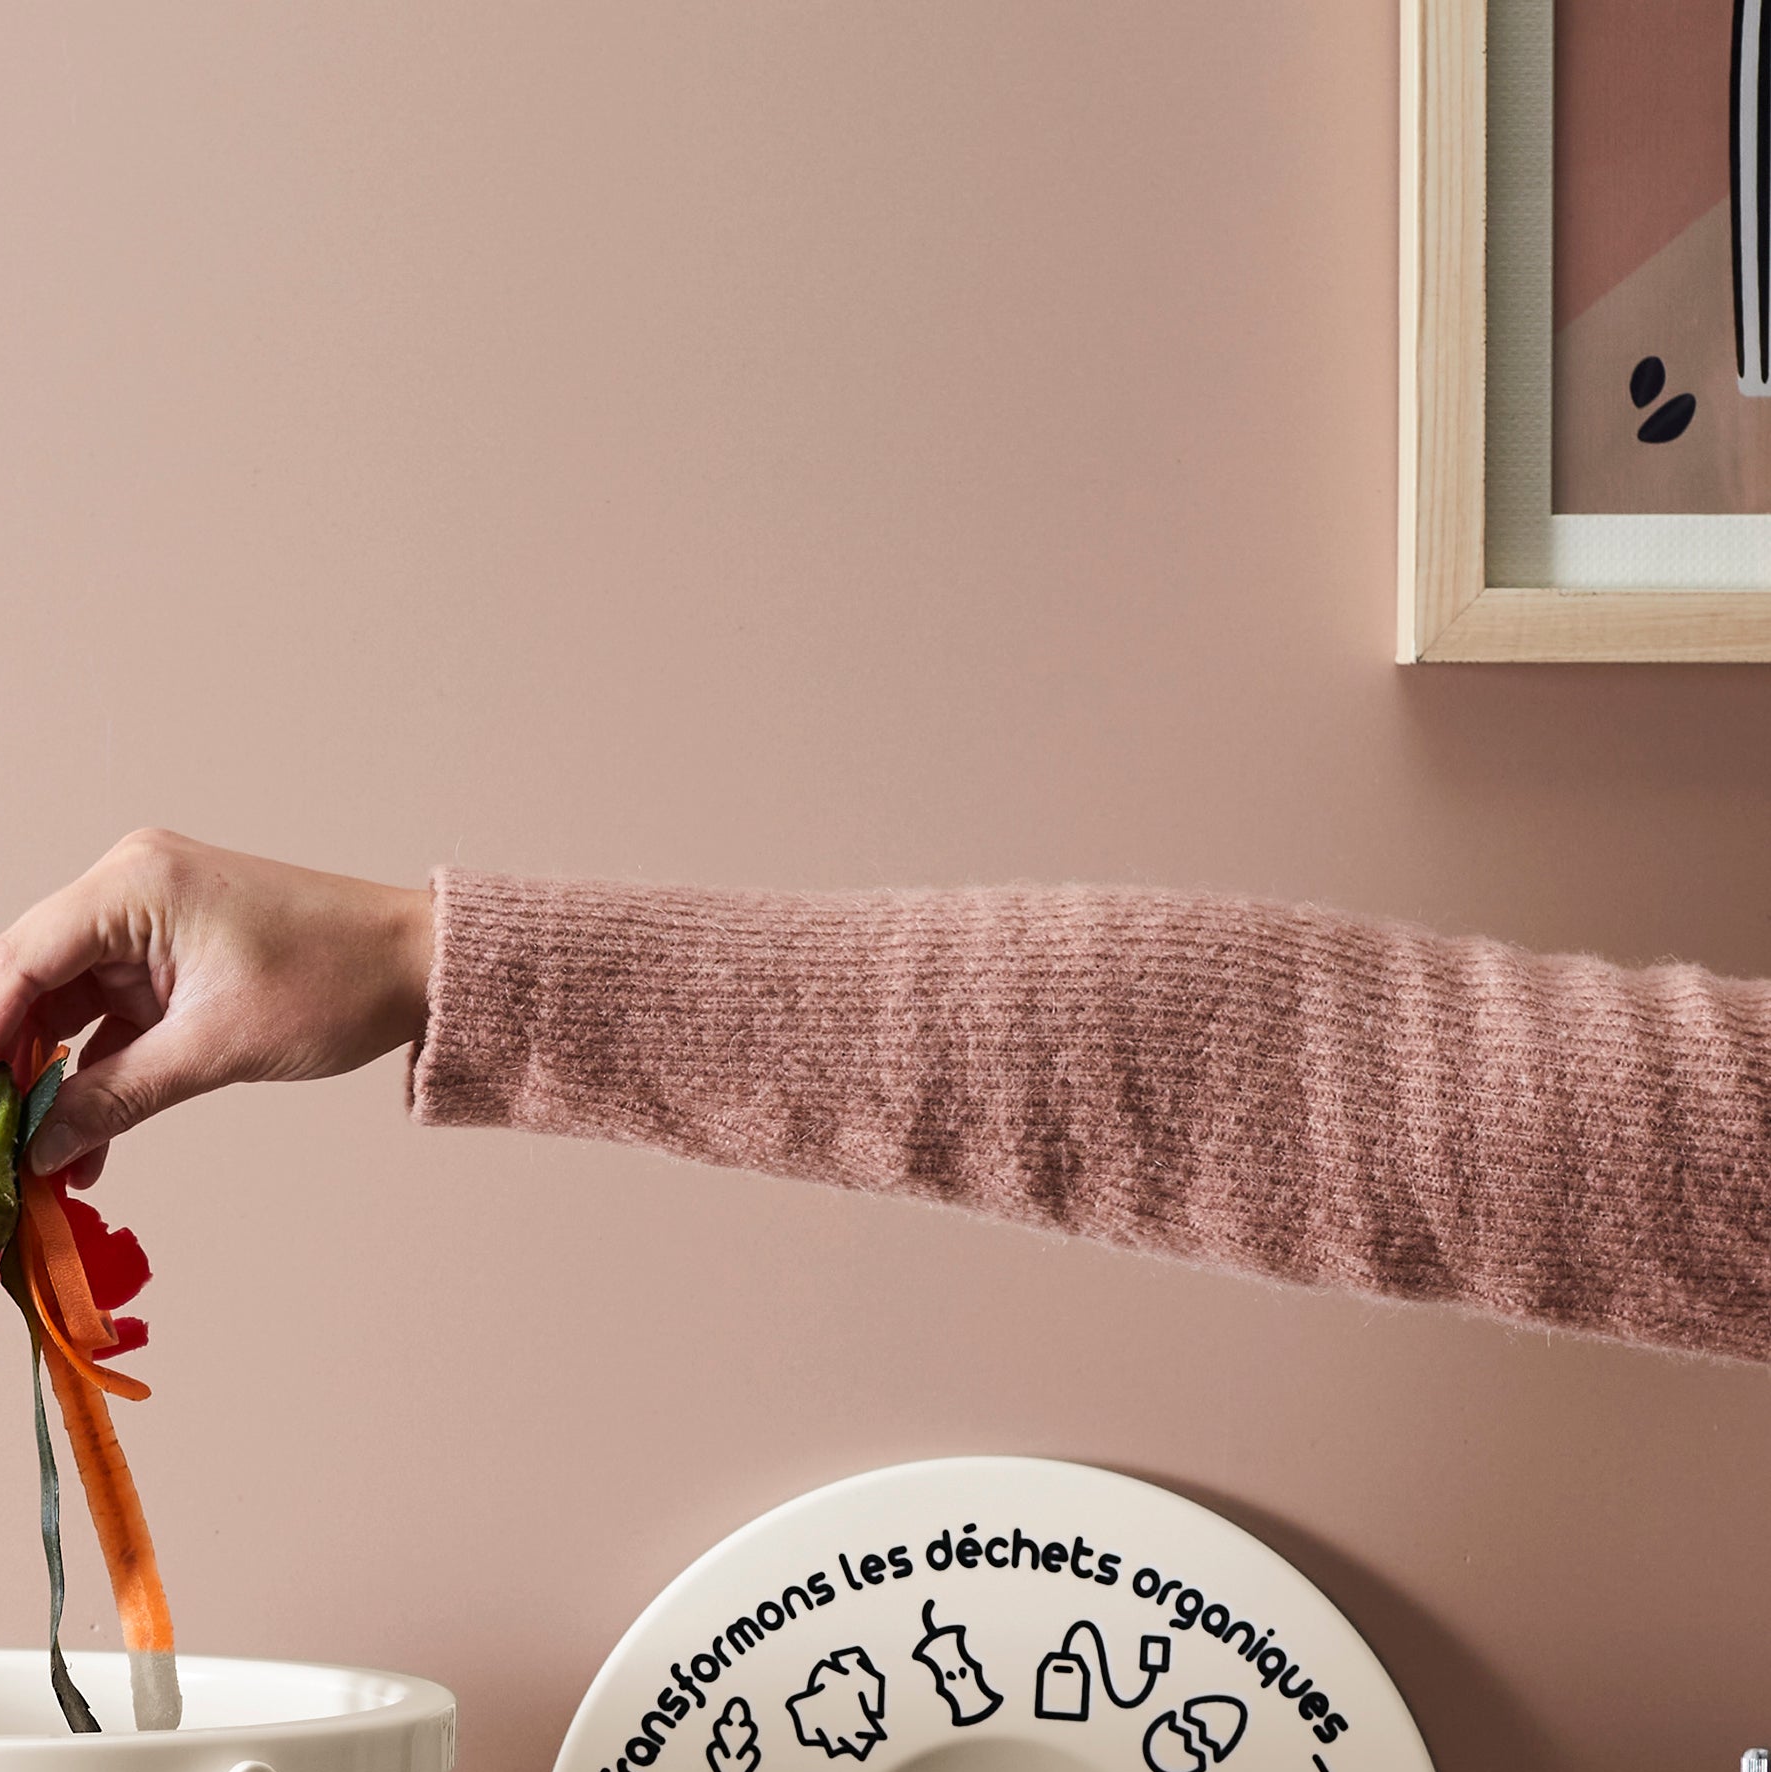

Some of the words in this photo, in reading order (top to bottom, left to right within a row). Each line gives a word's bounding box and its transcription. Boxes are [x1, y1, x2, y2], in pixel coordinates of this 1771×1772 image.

[838, 1545, 914, 1591] les
[925, 1523, 1122, 1587] déchets
[1132, 1567, 1349, 1744] organiques
